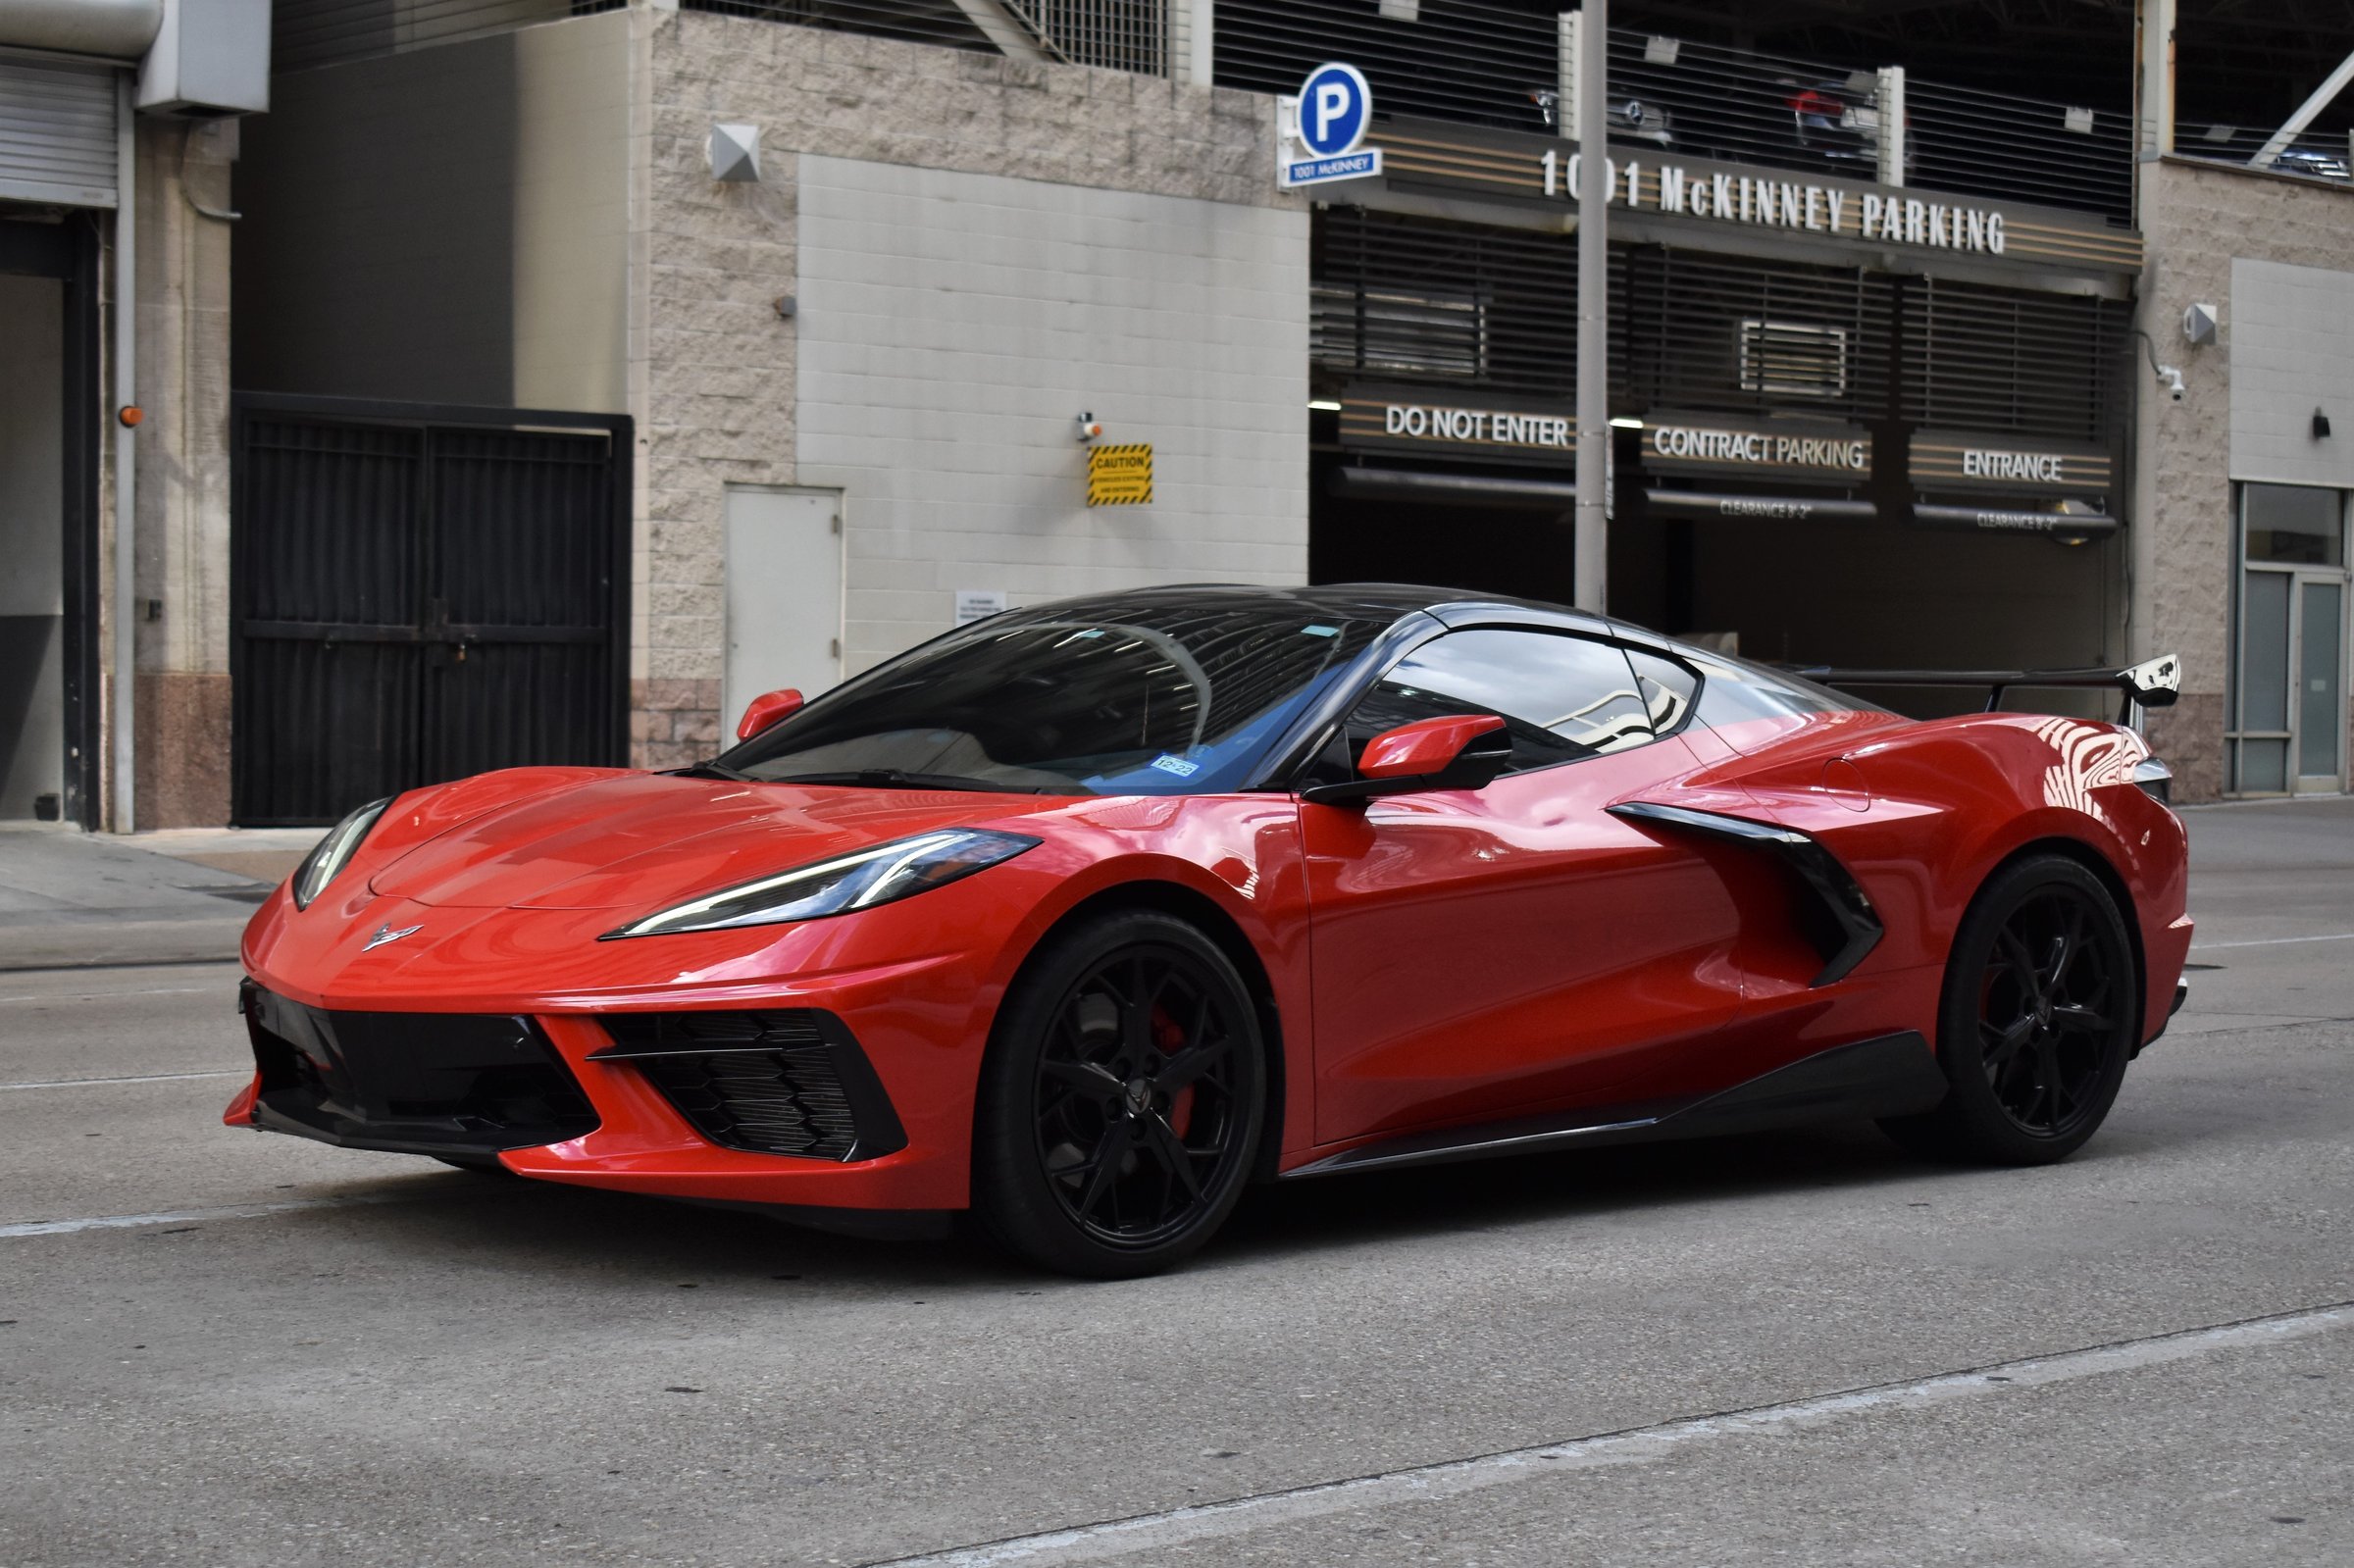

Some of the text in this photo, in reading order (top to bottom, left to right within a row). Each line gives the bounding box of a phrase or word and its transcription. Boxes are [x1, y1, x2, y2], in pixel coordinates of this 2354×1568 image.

[1316, 82, 1350, 142] P
[1294, 157, 1369, 179] 1001 McKINNEY
[1661, 166, 1844, 232] McKINNEY
[1863, 193, 2005, 255] PARKING
[1386, 405, 1568, 447] DO NOT ENTER
[1096, 456, 1145, 469] CAUTION
[1654, 427, 1863, 469] CONTRACT PARKING
[1963, 450, 2062, 481] ENTRANCE
[1720, 500, 1785, 518] CLEARANCE
[1976, 512, 2034, 530] CLEARANCE
